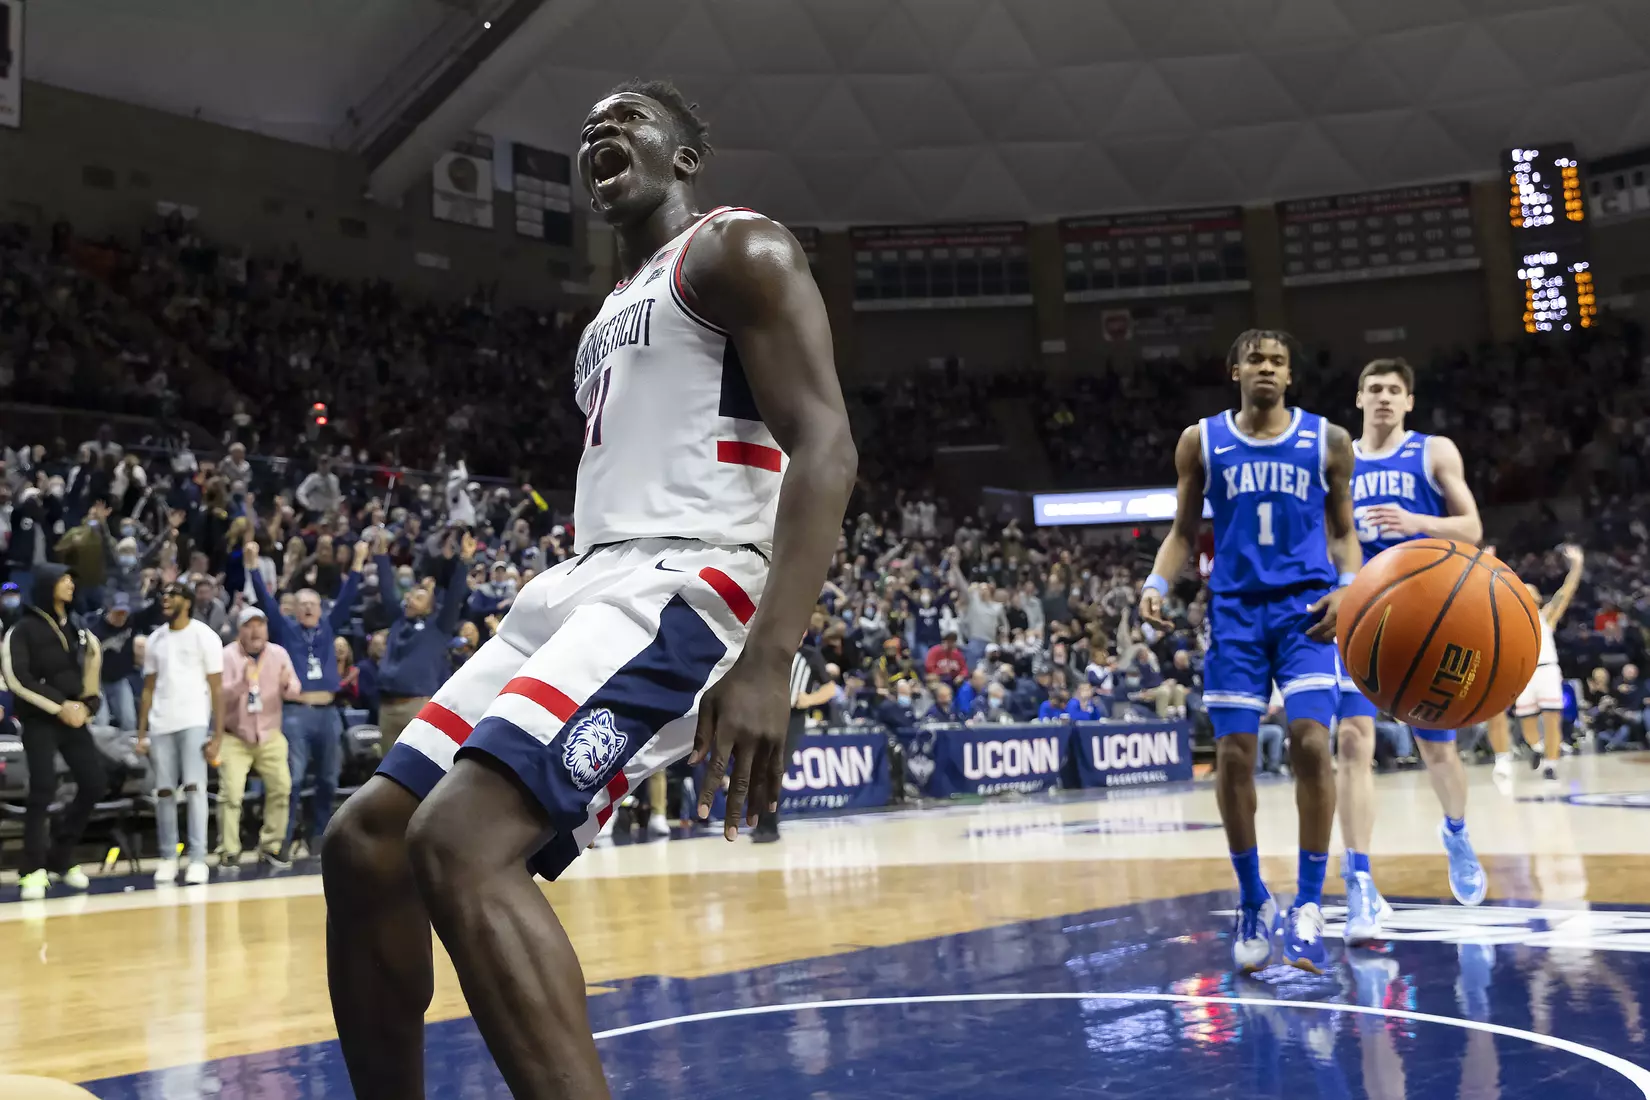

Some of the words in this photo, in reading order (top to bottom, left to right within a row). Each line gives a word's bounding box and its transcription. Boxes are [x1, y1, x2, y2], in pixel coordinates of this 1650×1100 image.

[1222, 460, 1311, 501] XAVIER
[1348, 469, 1416, 501] AVIER
[1256, 501, 1276, 547] 1
[1408, 642, 1474, 723] ELITE
[781, 745, 874, 792] CONN
[963, 736, 1060, 780] UCONN
[1091, 730, 1181, 772] UCONN
[1105, 770, 1169, 787] BASKETBALL
